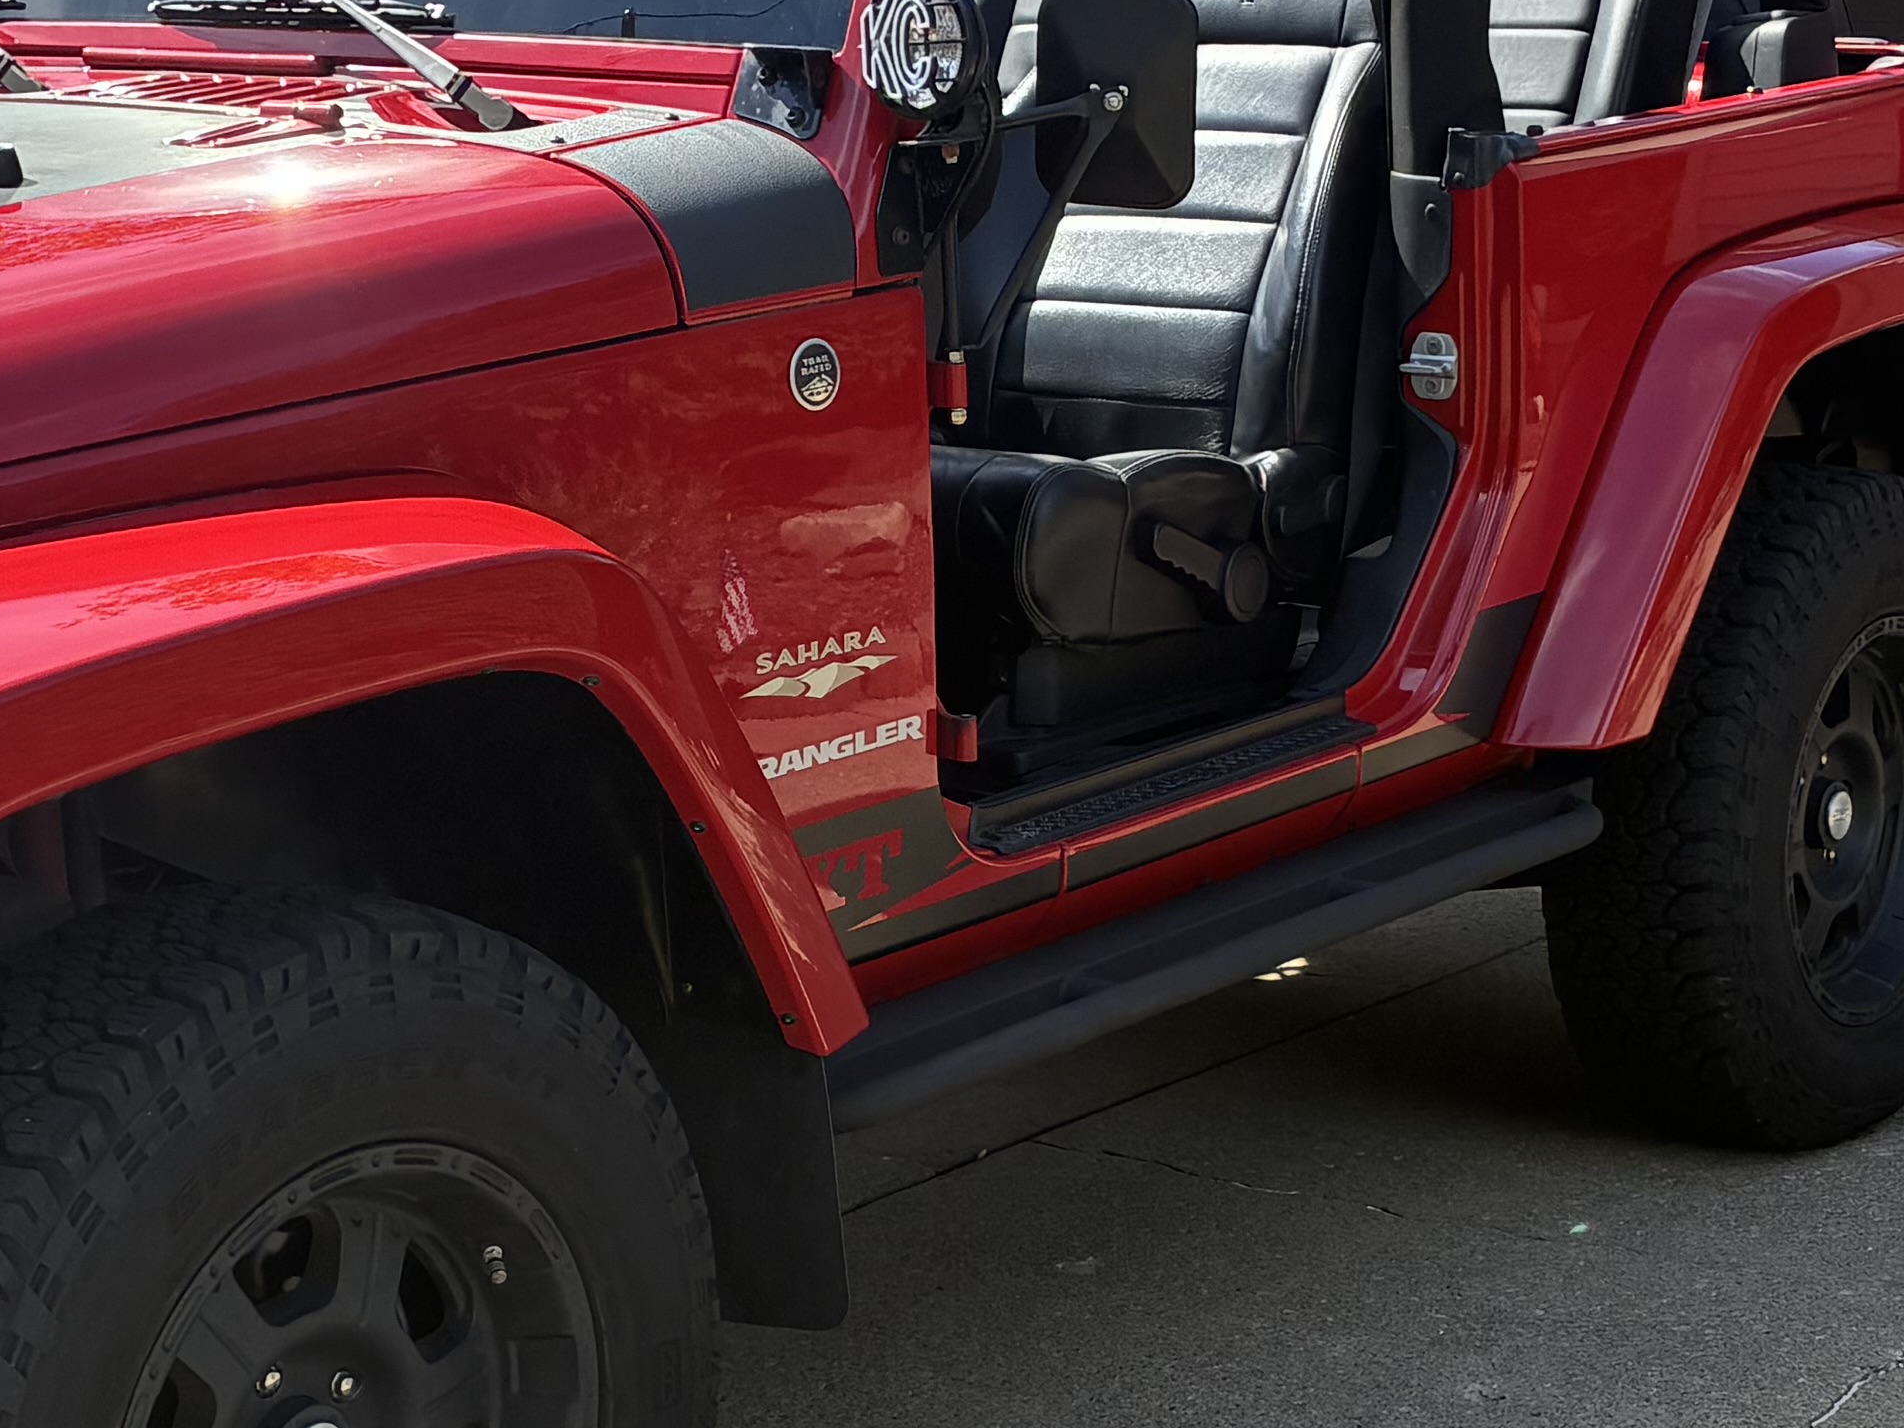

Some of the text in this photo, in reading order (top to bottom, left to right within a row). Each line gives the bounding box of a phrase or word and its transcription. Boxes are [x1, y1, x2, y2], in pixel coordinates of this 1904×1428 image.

[800, 363, 832, 376] RATED
[756, 626, 886, 675] SAHARA
[757, 715, 924, 780] RANGLER
